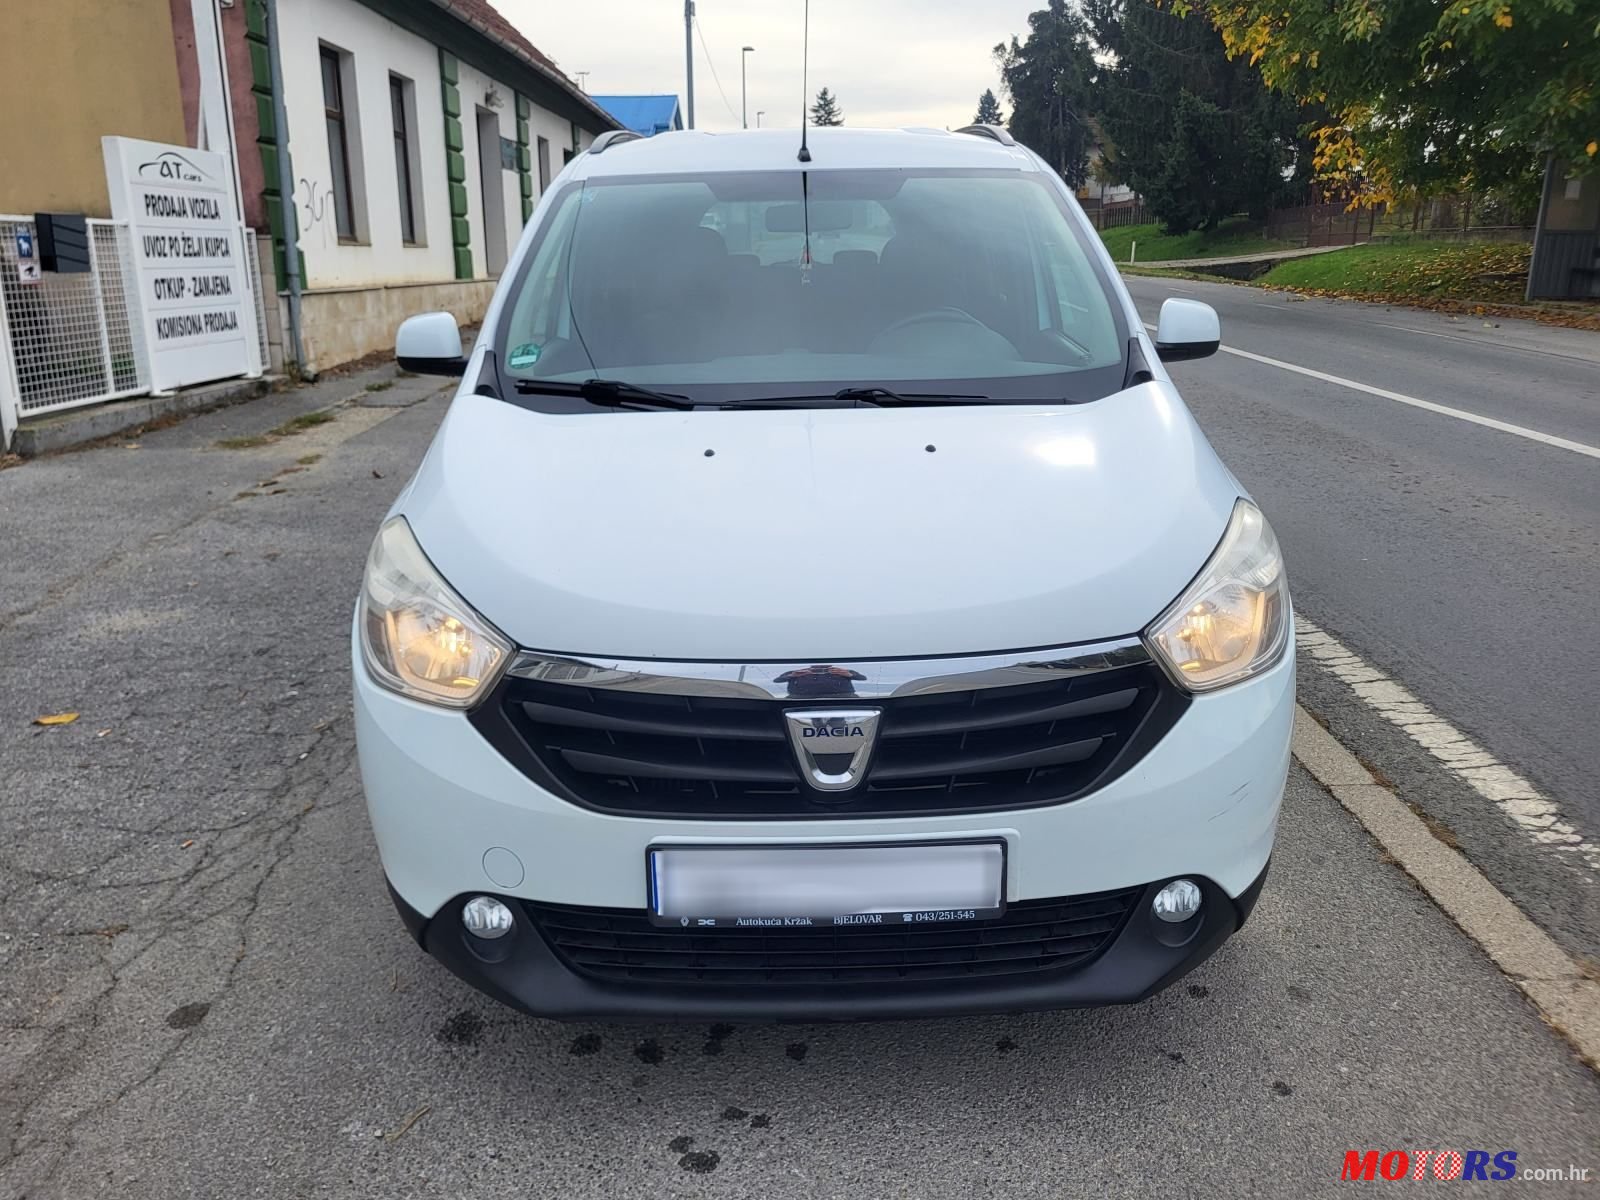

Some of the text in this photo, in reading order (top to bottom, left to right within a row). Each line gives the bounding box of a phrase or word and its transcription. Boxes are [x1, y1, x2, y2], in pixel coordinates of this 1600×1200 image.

[144, 193, 221, 220] PRODAJA VOZILA
[142, 235, 168, 258] UVOZ
[168, 235, 181, 258] PO
[204, 236, 231, 258] KUPCA
[154, 277, 185, 300] OTKUP
[192, 275, 232, 297] ZAMJENA
[156, 310, 239, 339] KOMISIONA PRODAJA
[802, 724, 864, 738] DACIA
[833, 913, 883, 926] BJELOVAR
[915, 910, 976, 922] 043/251-545
